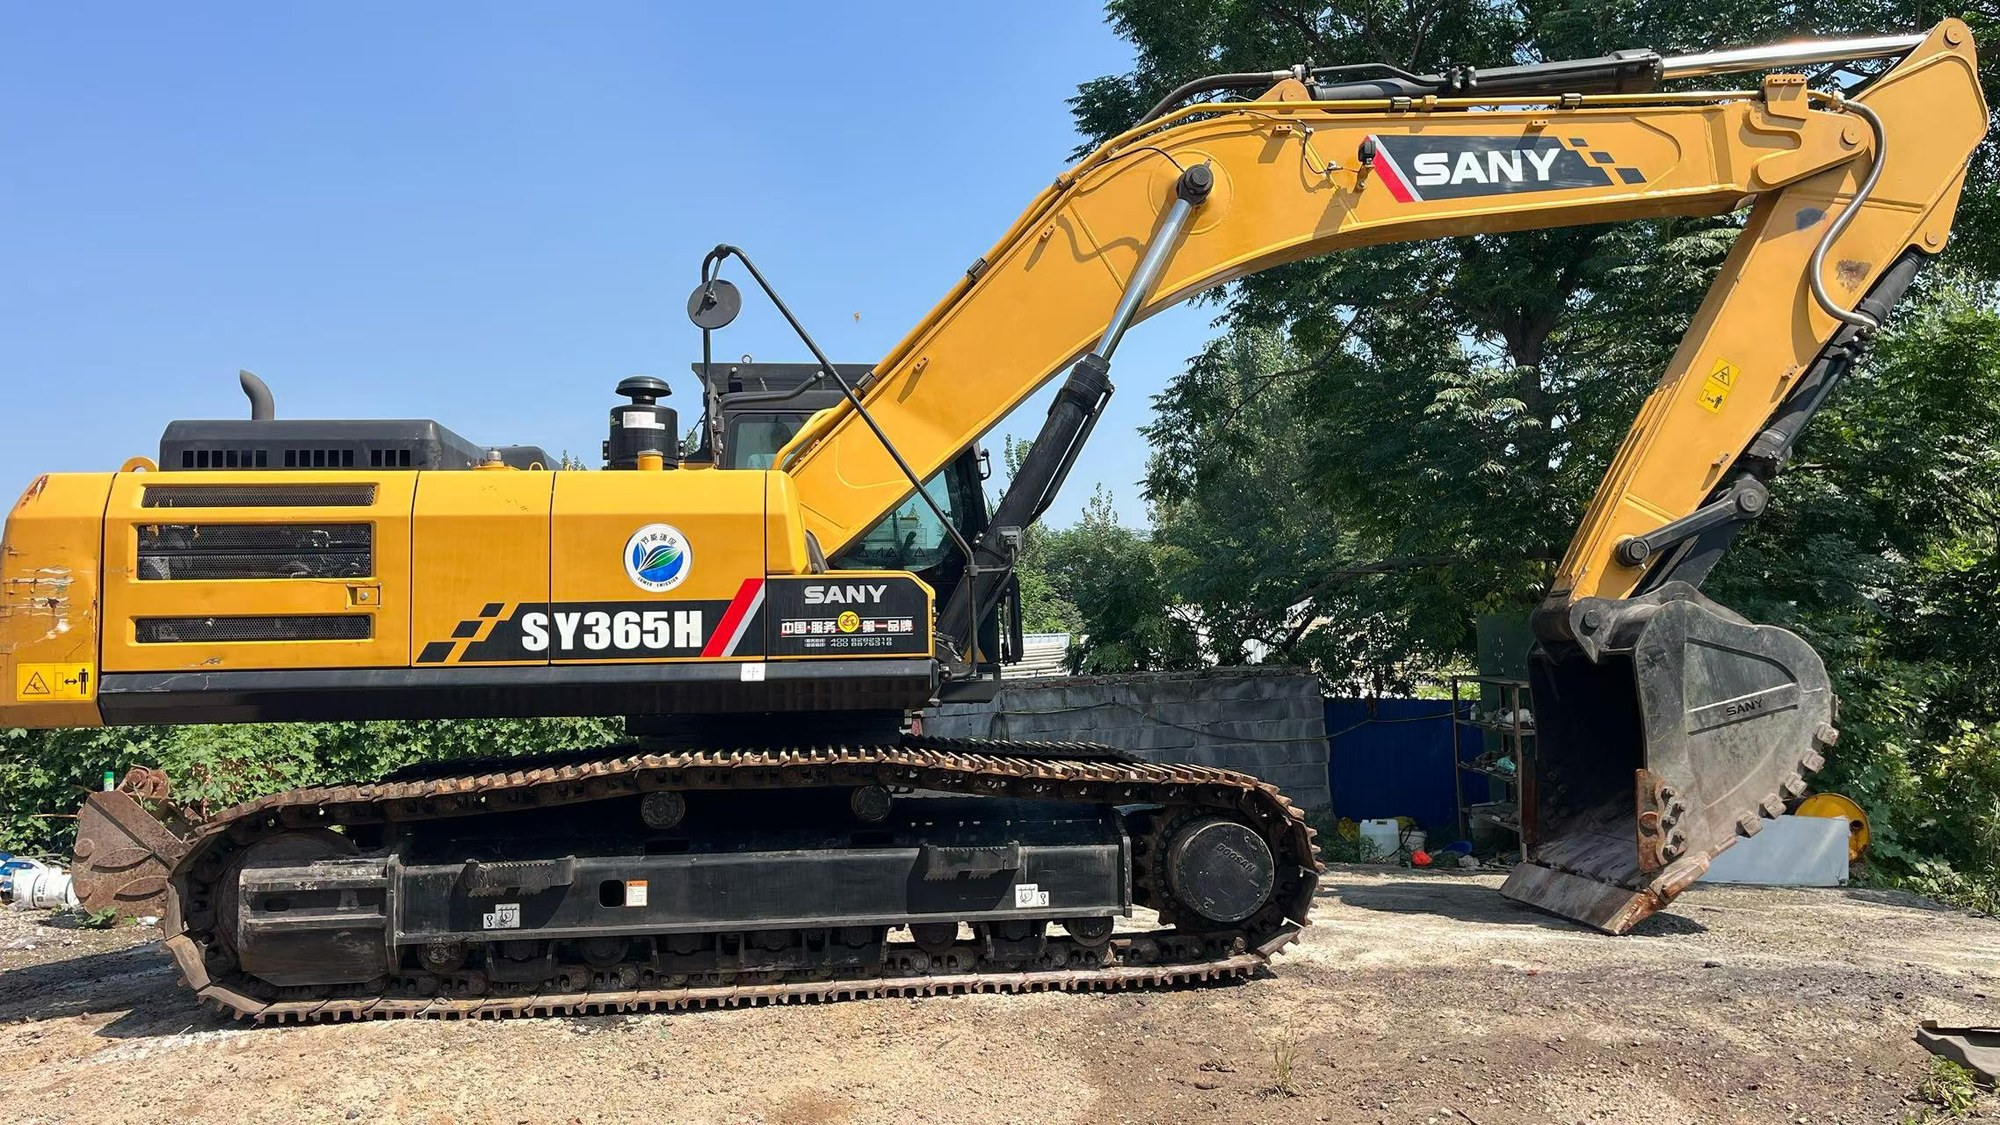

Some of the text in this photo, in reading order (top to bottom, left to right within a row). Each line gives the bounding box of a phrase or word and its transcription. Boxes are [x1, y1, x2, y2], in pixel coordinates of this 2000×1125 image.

[1413, 148, 1561, 186] SANY
[804, 585, 887, 604] SANY
[521, 610, 703, 652] SY365H
[862, 619, 913, 633] 第一品牌
[1726, 698, 1763, 716] SANY
[1216, 842, 1257, 873] DOOSAN
